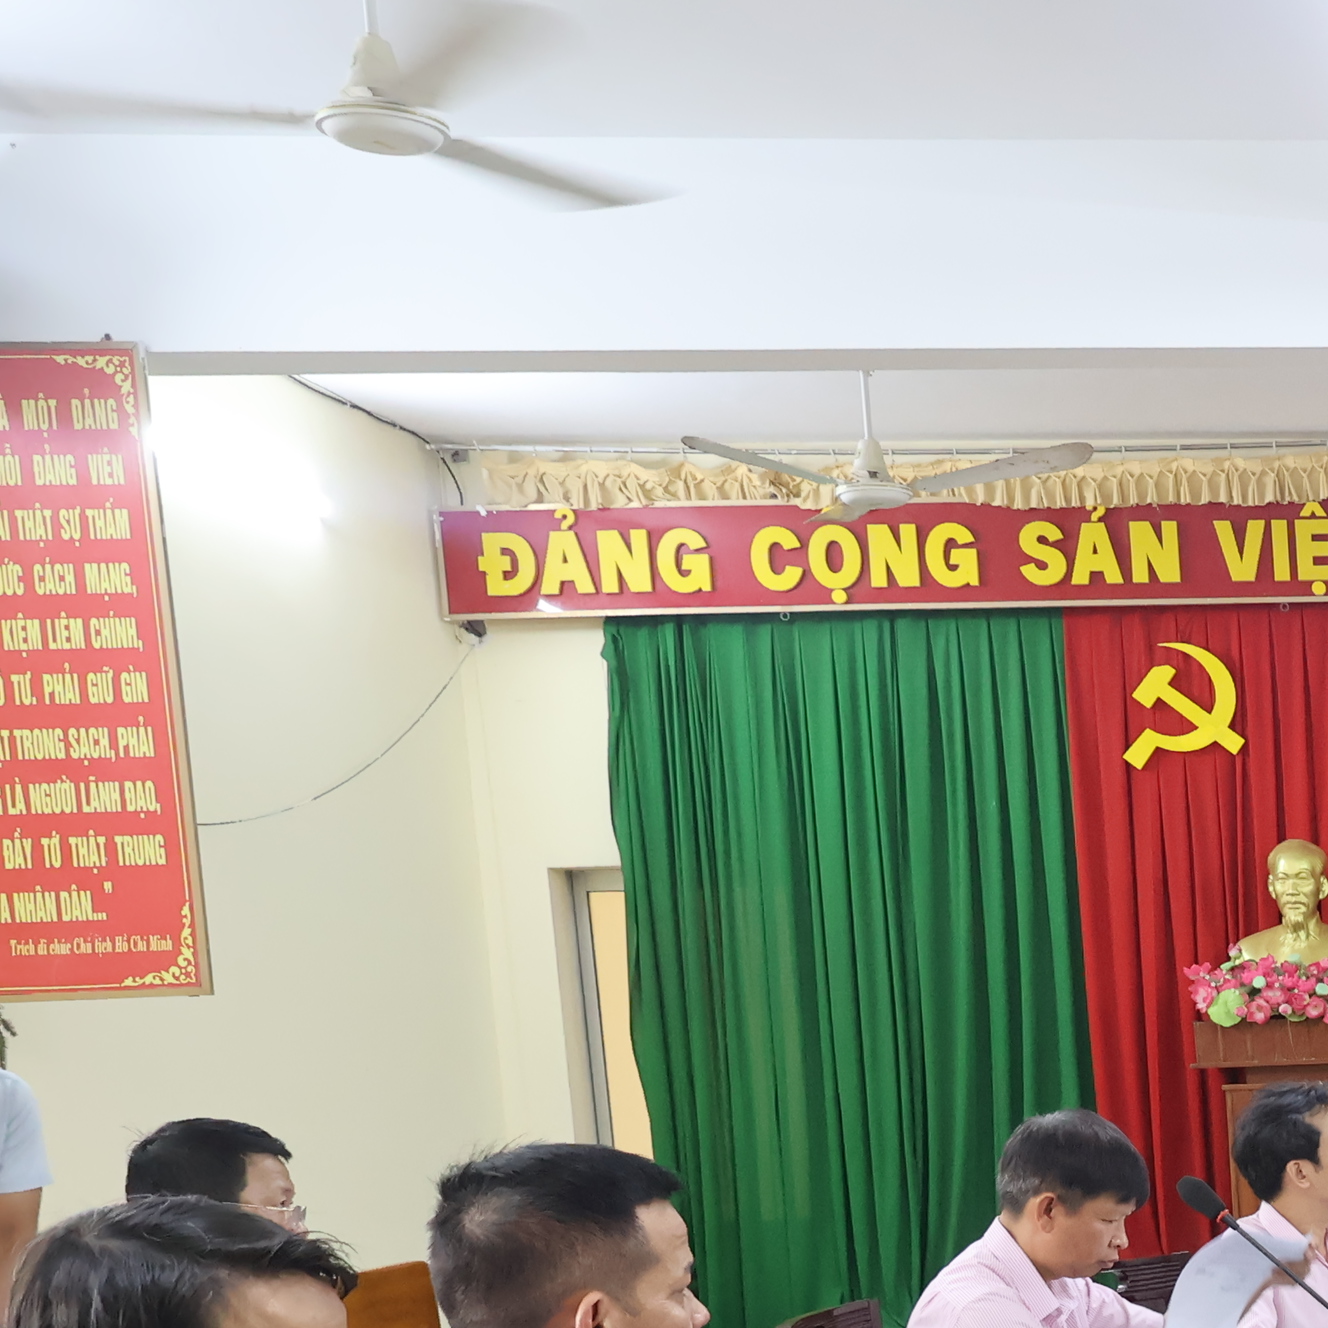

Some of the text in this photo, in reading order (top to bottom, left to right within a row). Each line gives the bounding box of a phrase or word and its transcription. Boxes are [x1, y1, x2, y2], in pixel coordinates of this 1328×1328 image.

[21, 392, 58, 438] MỘT
[32, 443, 125, 486] ĐẢNG VIÊN
[14, 502, 54, 547] THẬT
[58, 505, 82, 547] SỰ
[477, 507, 714, 598] ĐẢNG
[1018, 503, 1182, 586] SẢN
[33, 556, 76, 596] CÁCH
[84, 562, 138, 602] MẠNG,
[1, 610, 144, 658] KIỆM LIÊM CHÍNH,
[10, 671, 38, 706] TƯ.
[42, 662, 82, 705] PHẢI
[86, 666, 114, 704] GIỮ
[120, 665, 150, 703] GÌN
[13, 727, 66, 760] TRONG
[68, 727, 116, 766] SẠCH,
[116, 716, 156, 758] PHẢI
[5, 775, 161, 818] LÀ NGƯỜI LÃNH ĐẠO,
[2, 828, 166, 874] ĐẦY TỚ THẬT TRUNG
[13, 885, 58, 923] NHÂN
[10, 939, 34, 956] Trích
[115, 934, 128, 952] Hồ
[149, 935, 172, 951] Minh
